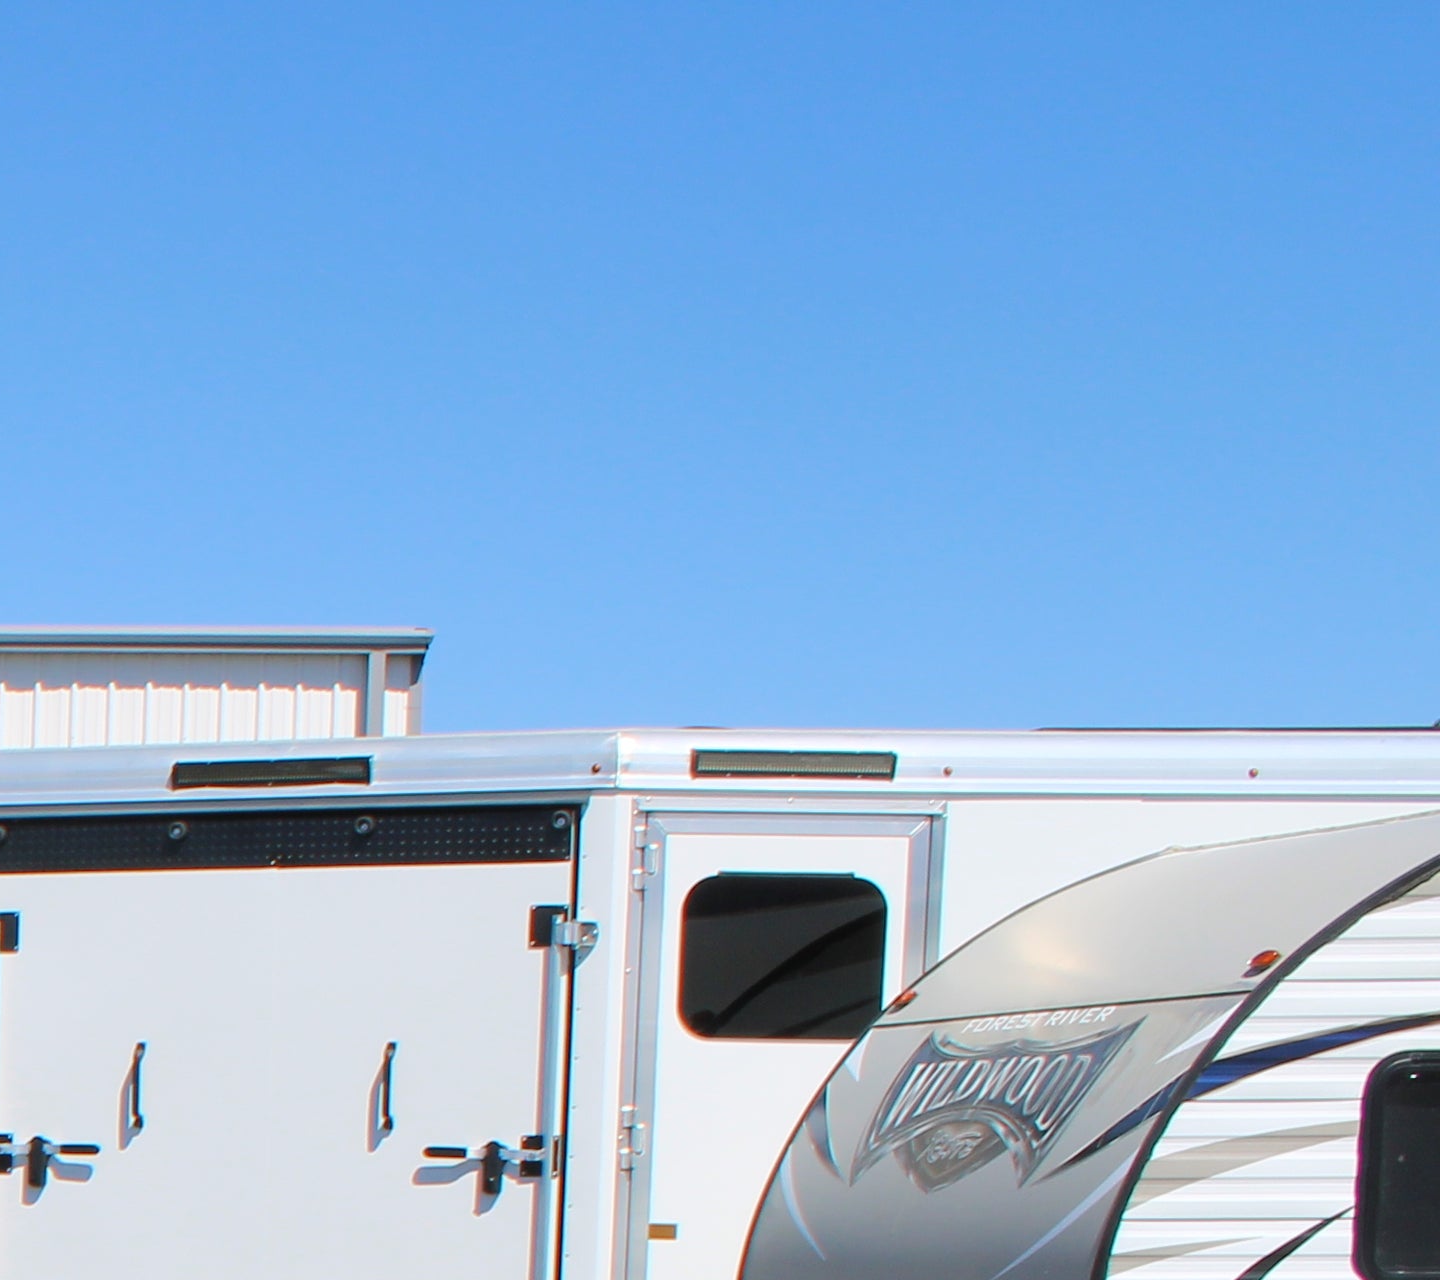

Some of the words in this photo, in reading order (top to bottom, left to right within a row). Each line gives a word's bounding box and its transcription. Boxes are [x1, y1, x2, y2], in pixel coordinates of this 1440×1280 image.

[961, 1011, 1044, 1034] FOREST
[1045, 1006, 1116, 1026] RIVER
[879, 1053, 1094, 1135] WILDWOOD
